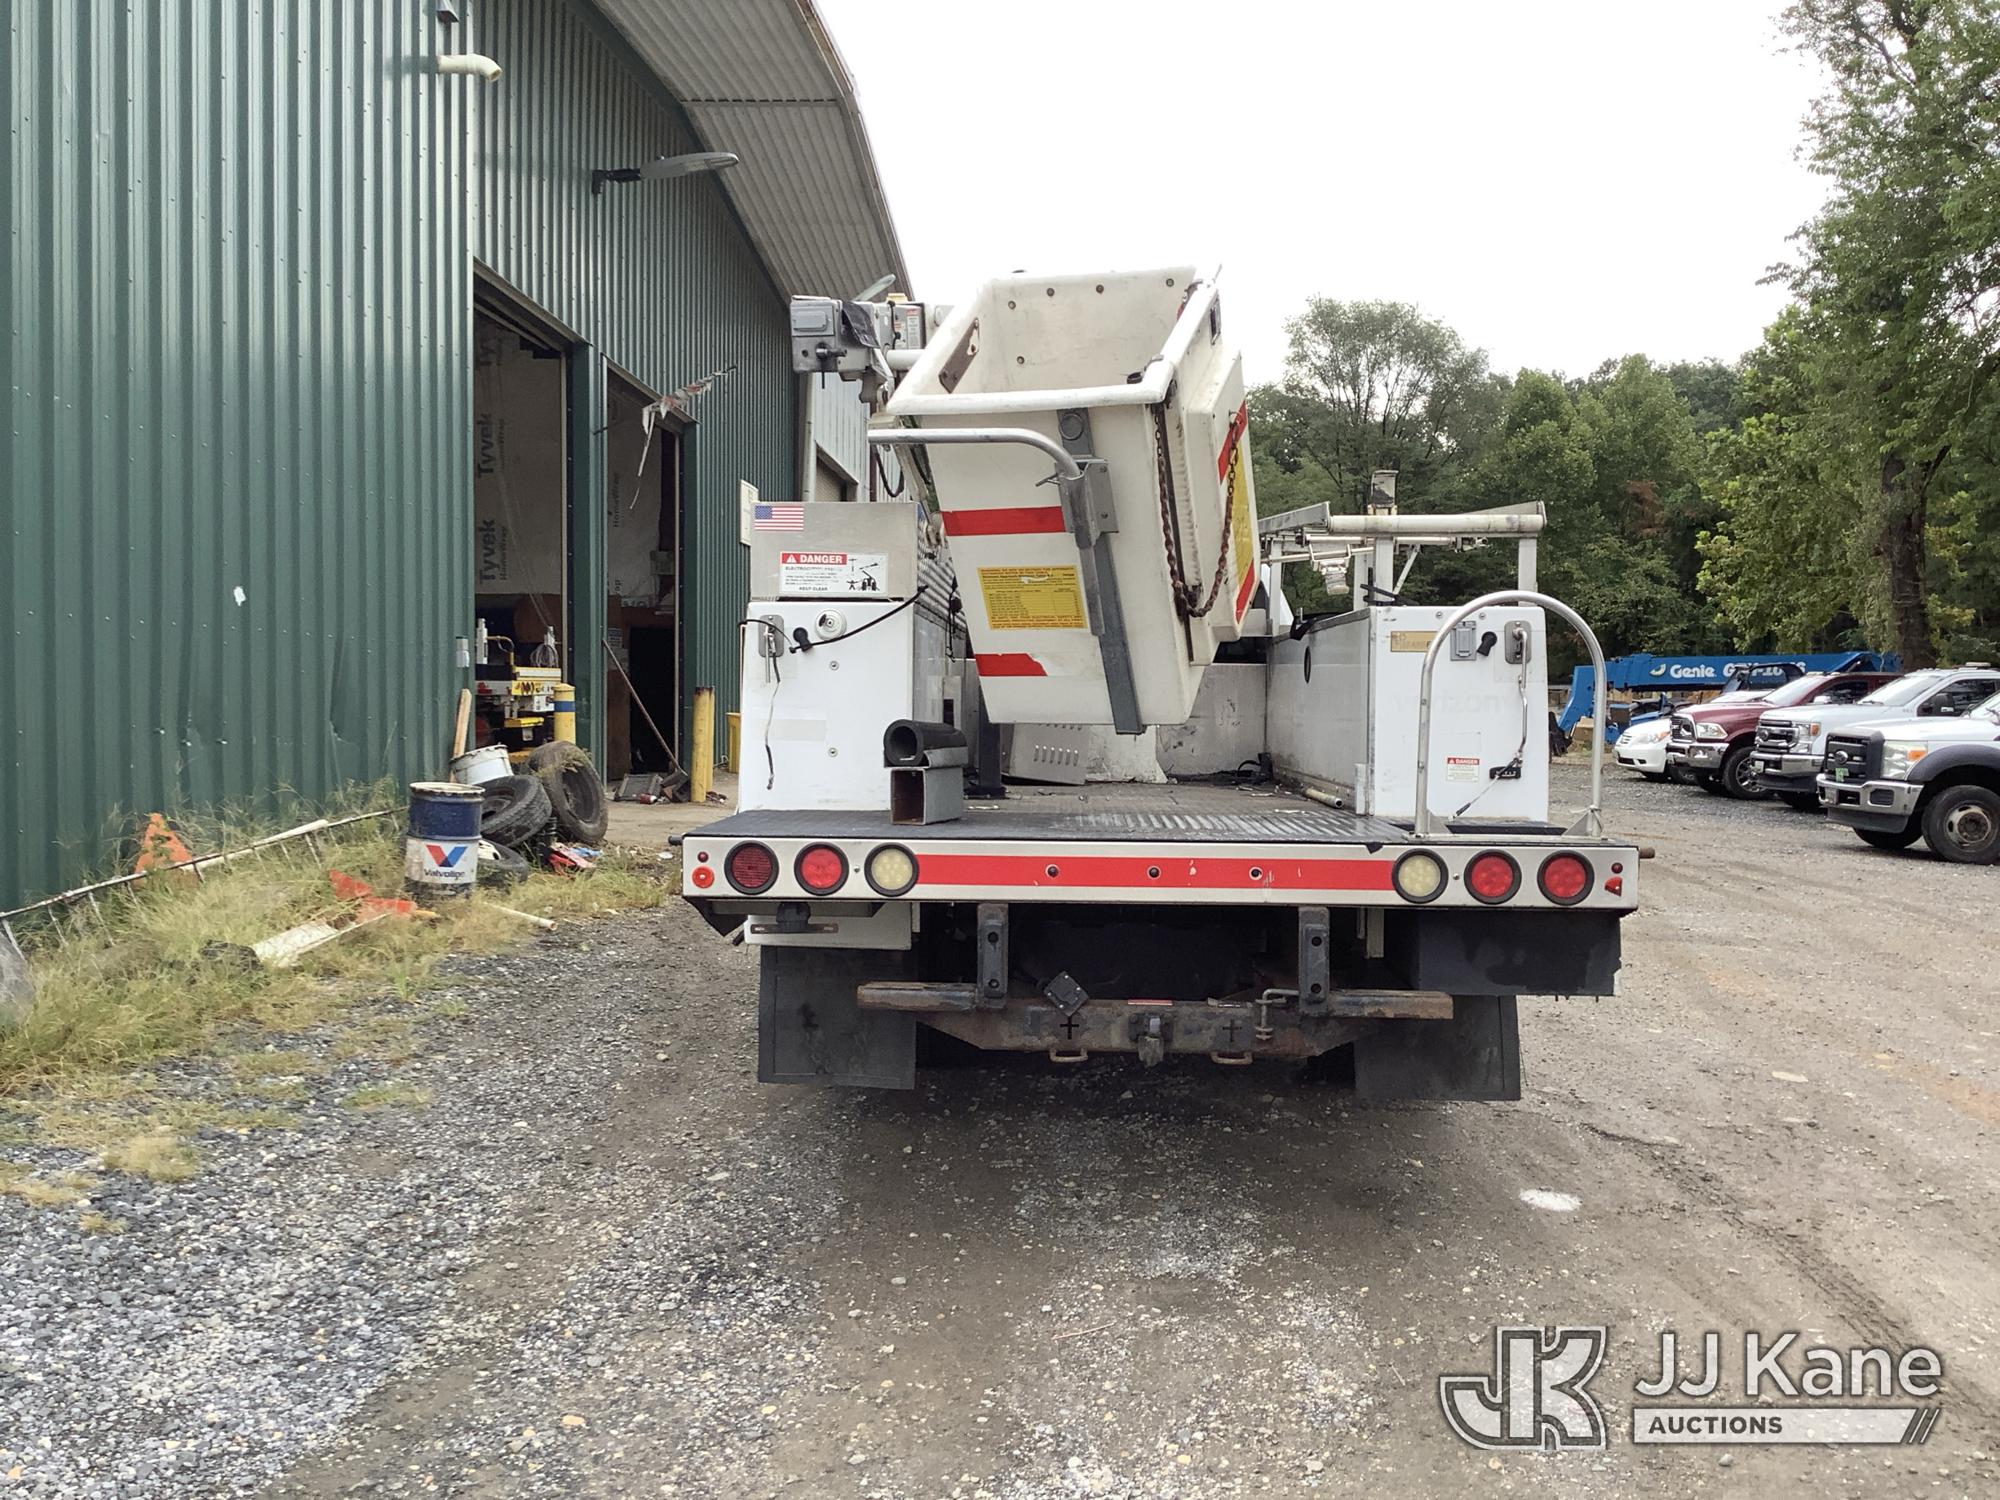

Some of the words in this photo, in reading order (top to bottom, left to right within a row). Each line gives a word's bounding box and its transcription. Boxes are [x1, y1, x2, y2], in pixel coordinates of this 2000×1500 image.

[478, 520, 499, 586] Tyvek
[800, 554, 843, 564] DANGER
[1670, 664, 1716, 678] Genie
